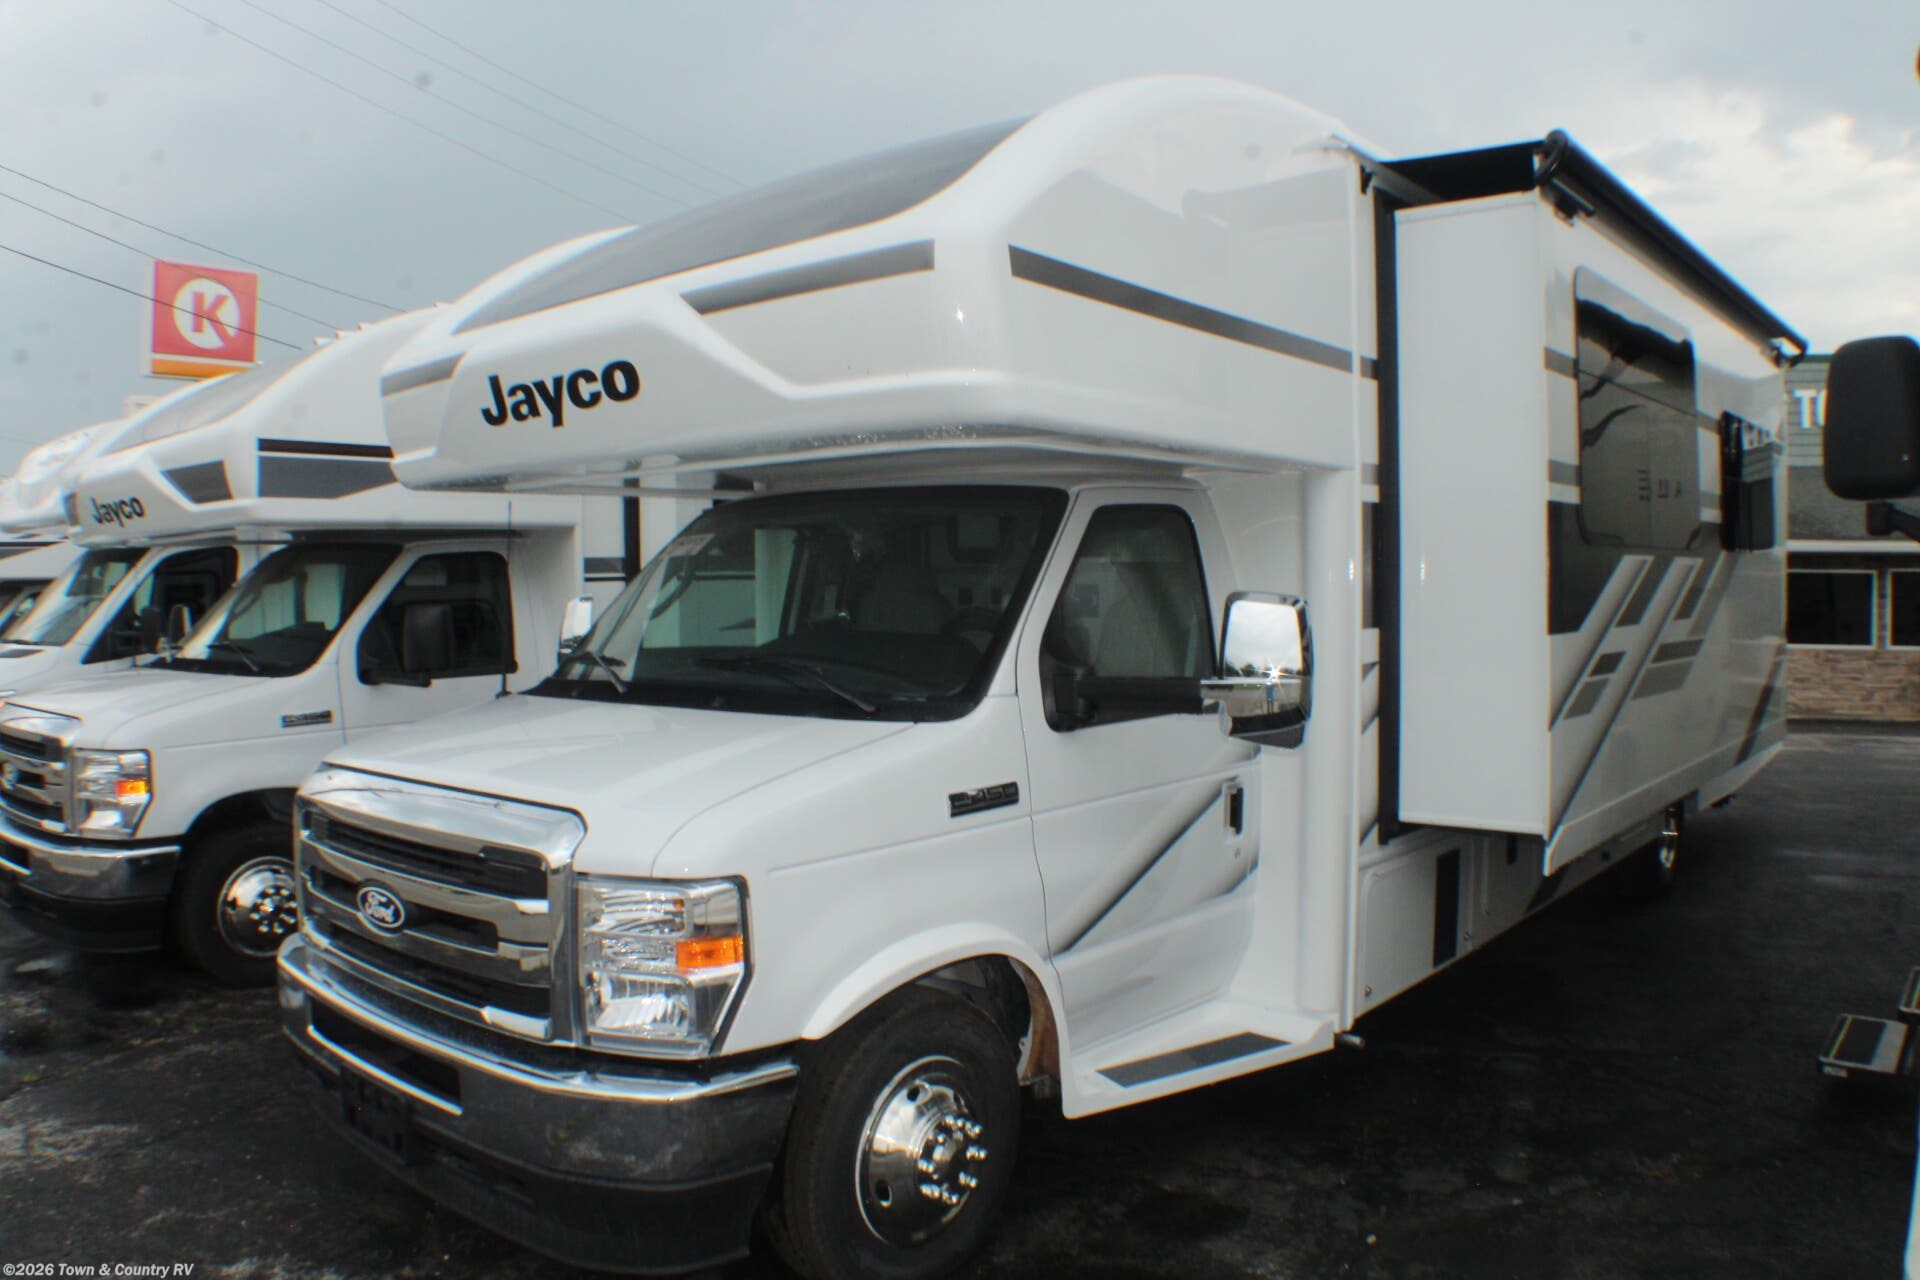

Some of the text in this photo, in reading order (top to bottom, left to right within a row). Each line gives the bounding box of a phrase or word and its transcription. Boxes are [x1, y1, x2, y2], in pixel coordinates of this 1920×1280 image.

[191, 290, 236, 347] K
[480, 359, 641, 428] Jayco
[89, 496, 147, 528] Jayco
[364, 890, 396, 922] Ford
